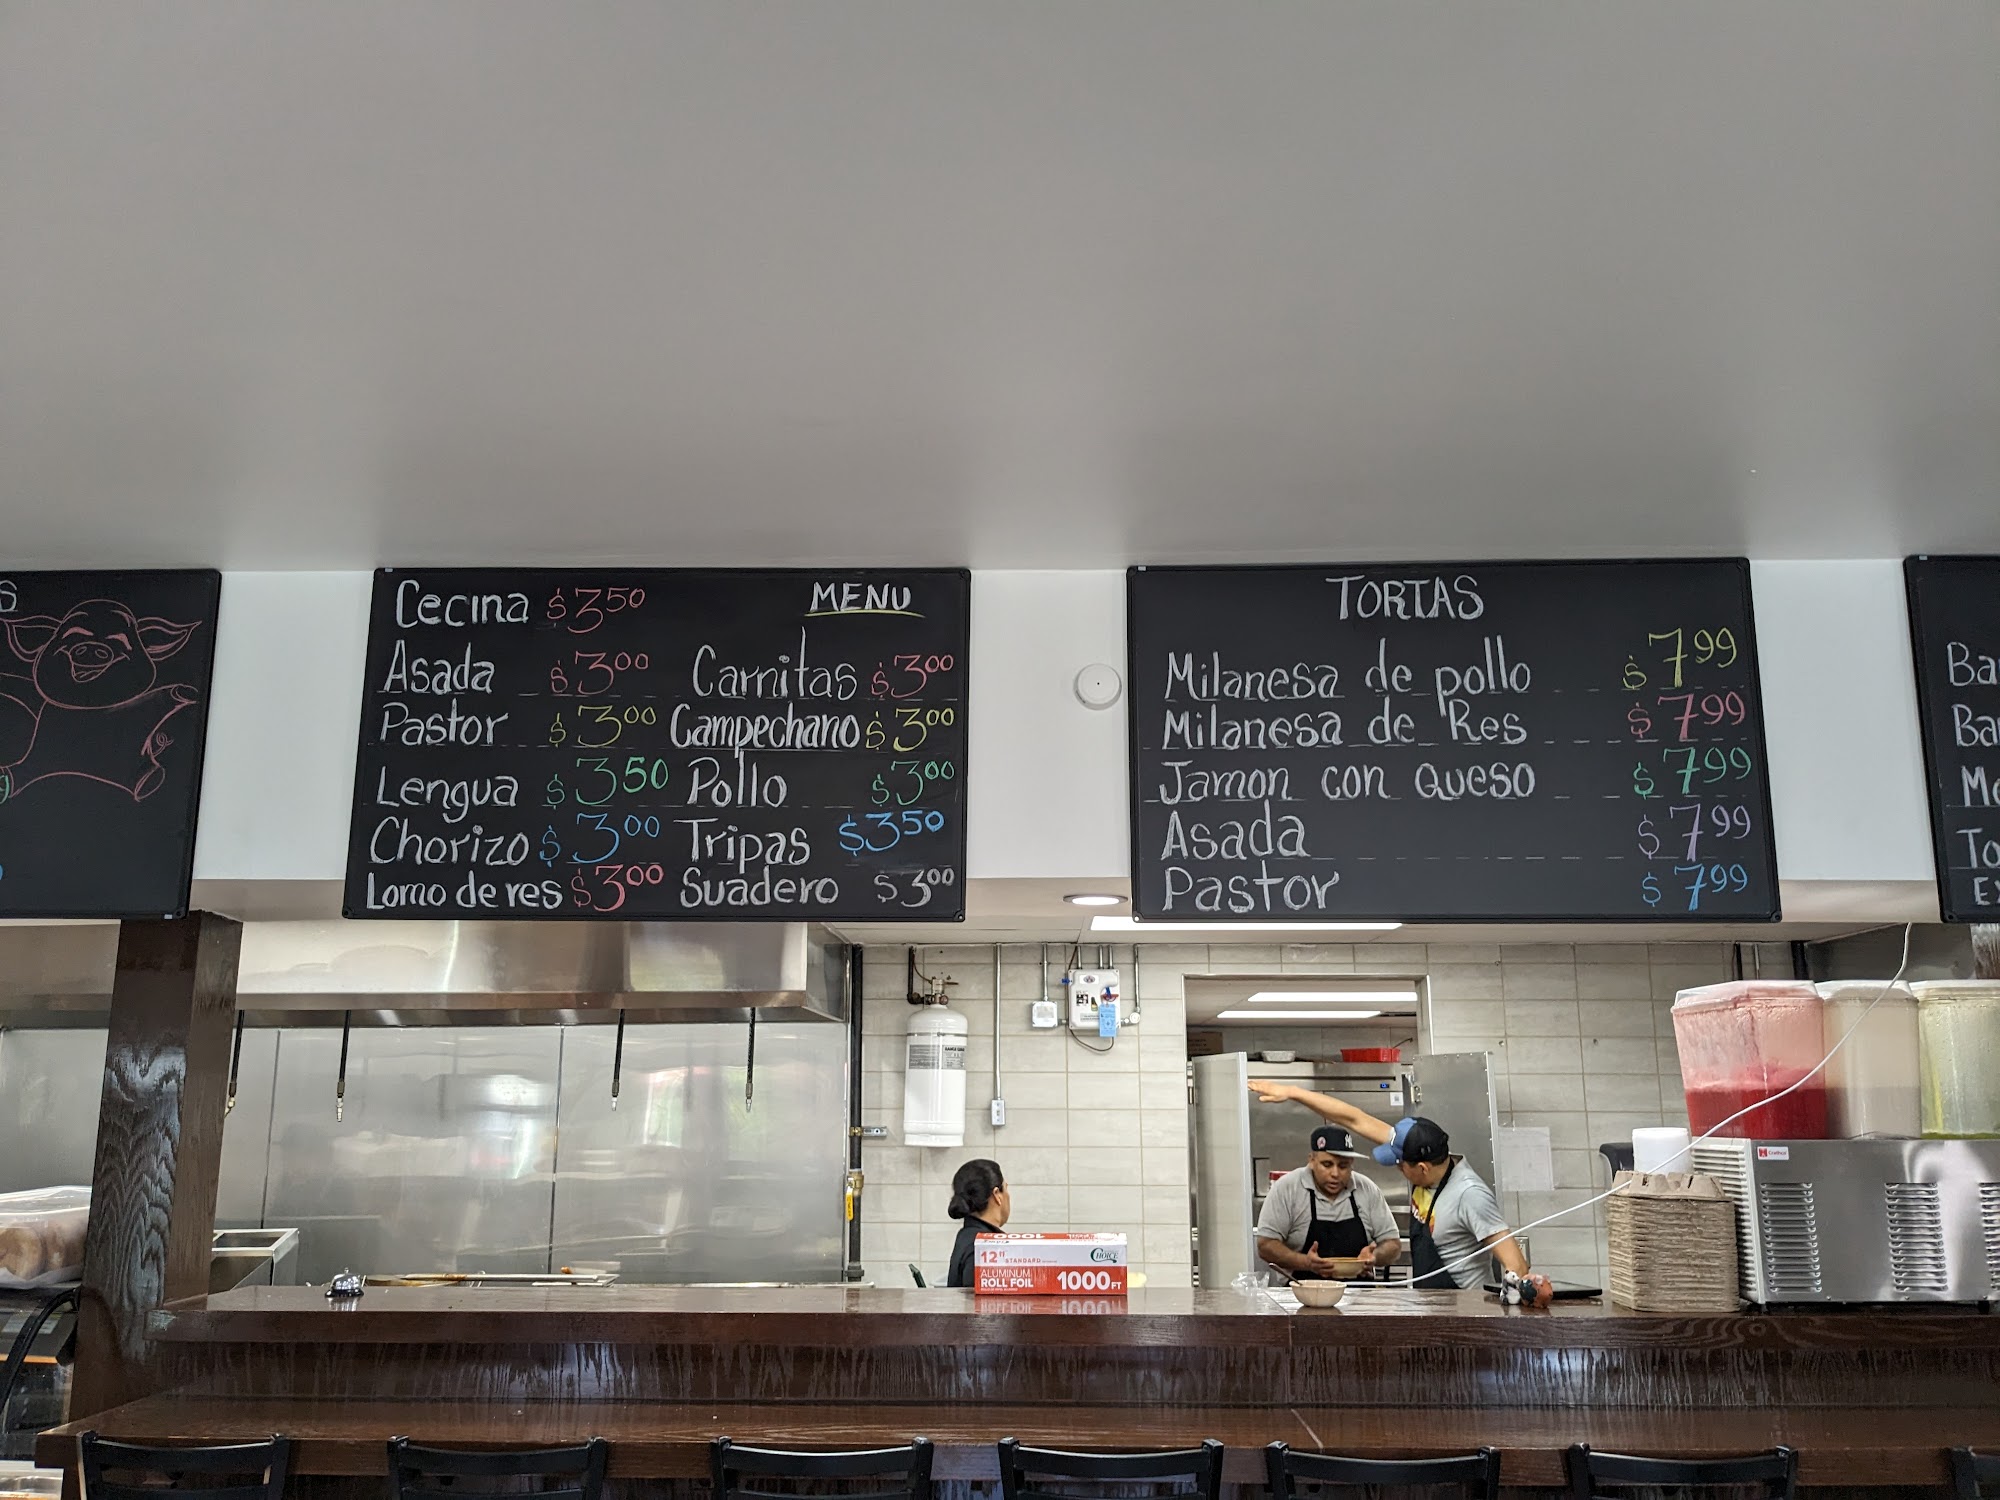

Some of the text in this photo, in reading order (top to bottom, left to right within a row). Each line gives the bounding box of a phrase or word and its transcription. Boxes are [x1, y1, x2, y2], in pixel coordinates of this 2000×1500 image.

[396, 579, 529, 628] Cecina
[810, 582, 912, 611] MENU
[1326, 574, 1484, 620] TORTAS
[384, 640, 494, 694] Asada
[692, 626, 858, 699] Carnitas
[1164, 651, 1339, 701] Milanesa
[1365, 638, 1412, 694] de
[1435, 635, 1531, 716] pollo
[1946, 641, 2000, 687] Ba
[380, 698, 508, 747] Pastor
[670, 702, 860, 752] Campechano
[1162, 704, 1343, 750] Milanesa
[1368, 698, 1415, 745] de
[1450, 699, 1528, 743] Res
[1951, 703, 2000, 747] Ba
[377, 765, 519, 823] Lengua
[687, 750, 787, 808] Pollo
[1160, 760, 1291, 803] Jamon
[1321, 762, 1391, 799] con
[1414, 761, 1535, 800] Queso
[370, 817, 530, 866] Chorizo
[674, 817, 811, 873] Tripas
[1161, 799, 1311, 861] Asada
[366, 871, 447, 910] Lomo
[456, 870, 497, 908] de
[506, 879, 563, 909] res
[680, 865, 839, 908] Suadero
[1162, 858, 1340, 913] Pastor
[980, 1268, 1031, 1278] ALUMINUM
[980, 1278, 1008, 1288] ROLL
[1010, 1278, 1034, 1288] FOIL
[1057, 1271, 1111, 1290] 1000
[1111, 1281, 1122, 1290] FT
